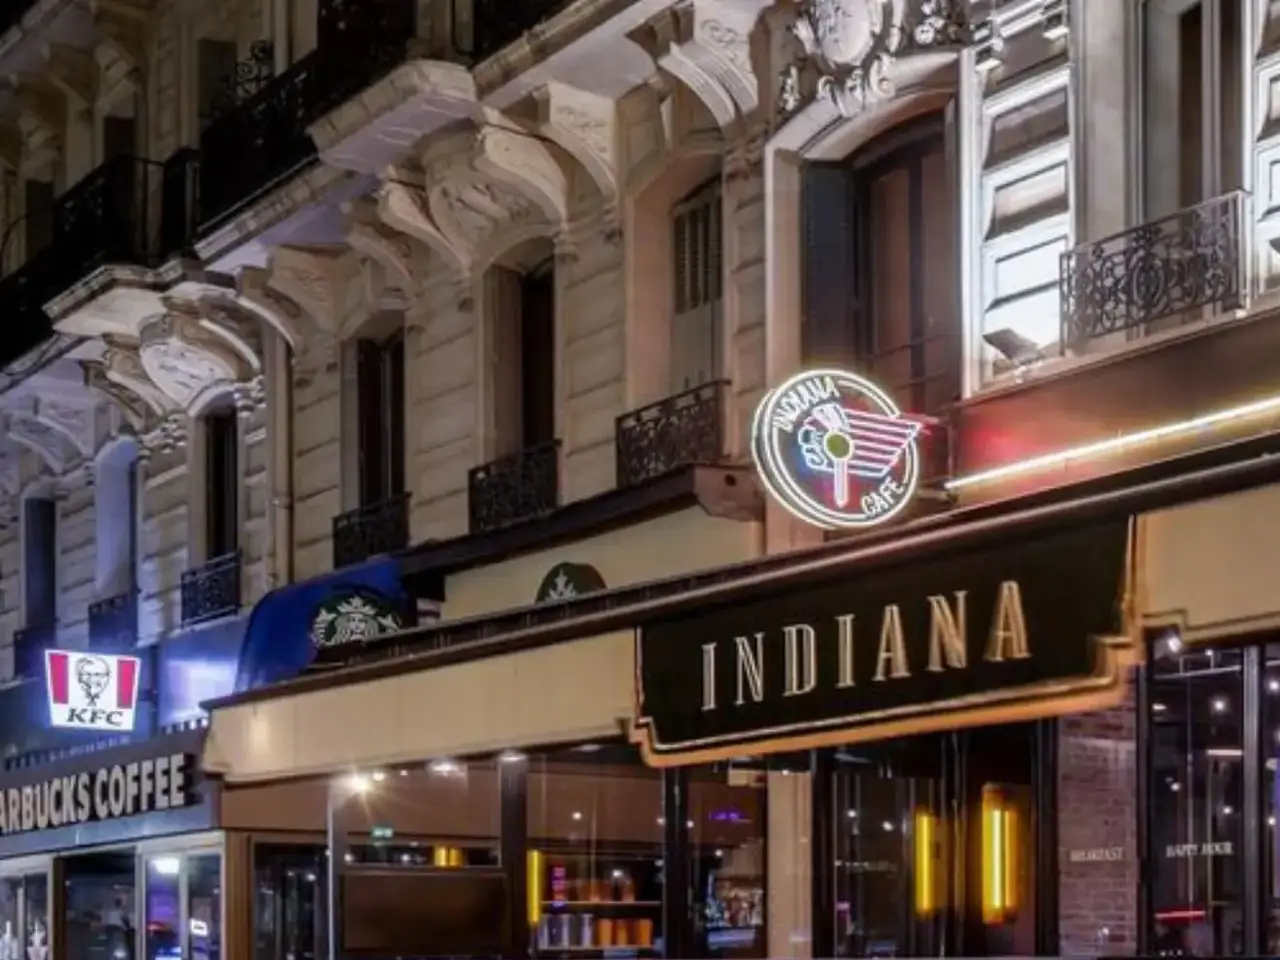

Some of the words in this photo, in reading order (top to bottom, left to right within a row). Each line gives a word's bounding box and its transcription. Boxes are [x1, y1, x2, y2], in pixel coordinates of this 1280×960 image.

[773, 376, 841, 432] INDIANA
[860, 475, 904, 516] CAFE
[702, 580, 1031, 711] INDIANA
[66, 707, 123, 726] KFC
[95, 753, 185, 818] COFFEE
